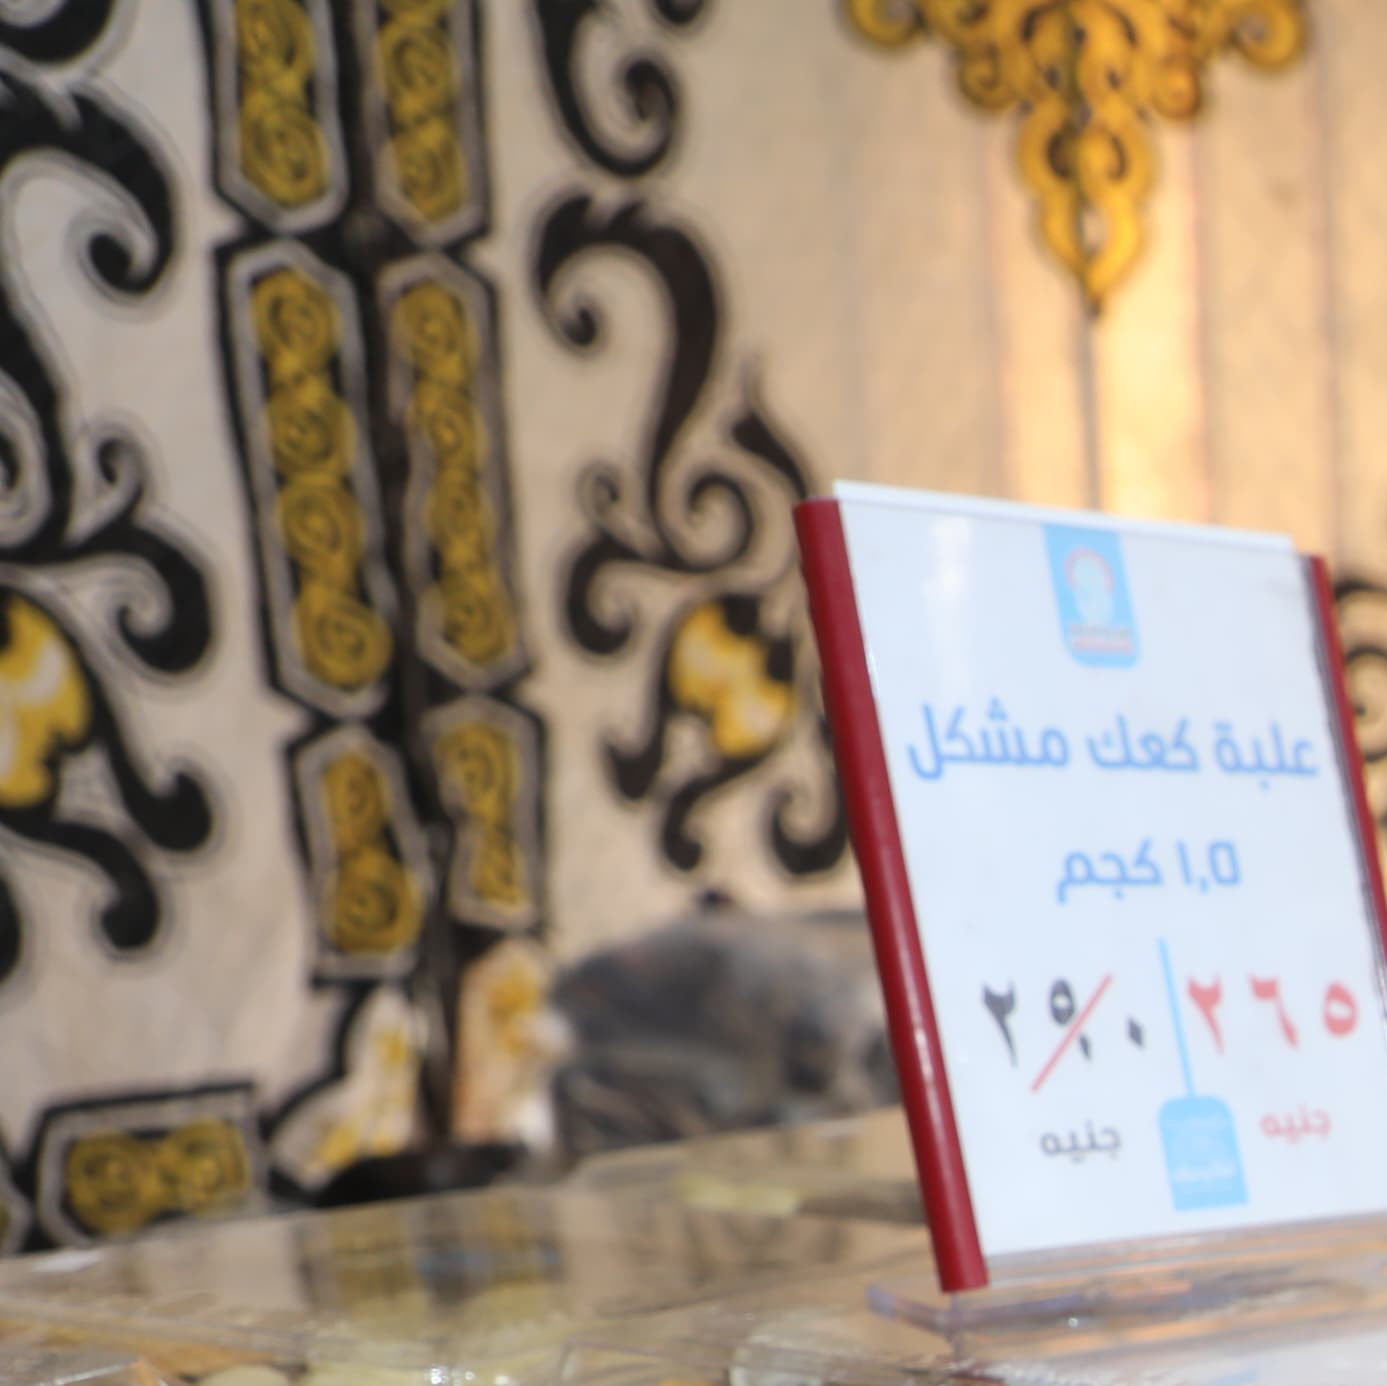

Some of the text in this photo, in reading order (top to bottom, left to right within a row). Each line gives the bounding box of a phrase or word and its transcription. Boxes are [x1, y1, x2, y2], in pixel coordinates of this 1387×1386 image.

[908, 697, 1318, 790] علبة كعك مشكل
[1056, 836, 1163, 906] كجم
[1187, 973, 1358, 1055] ٢٦٥
[1039, 1120, 1121, 1163] جنيه
[1261, 1105, 1331, 1144] جنيه
